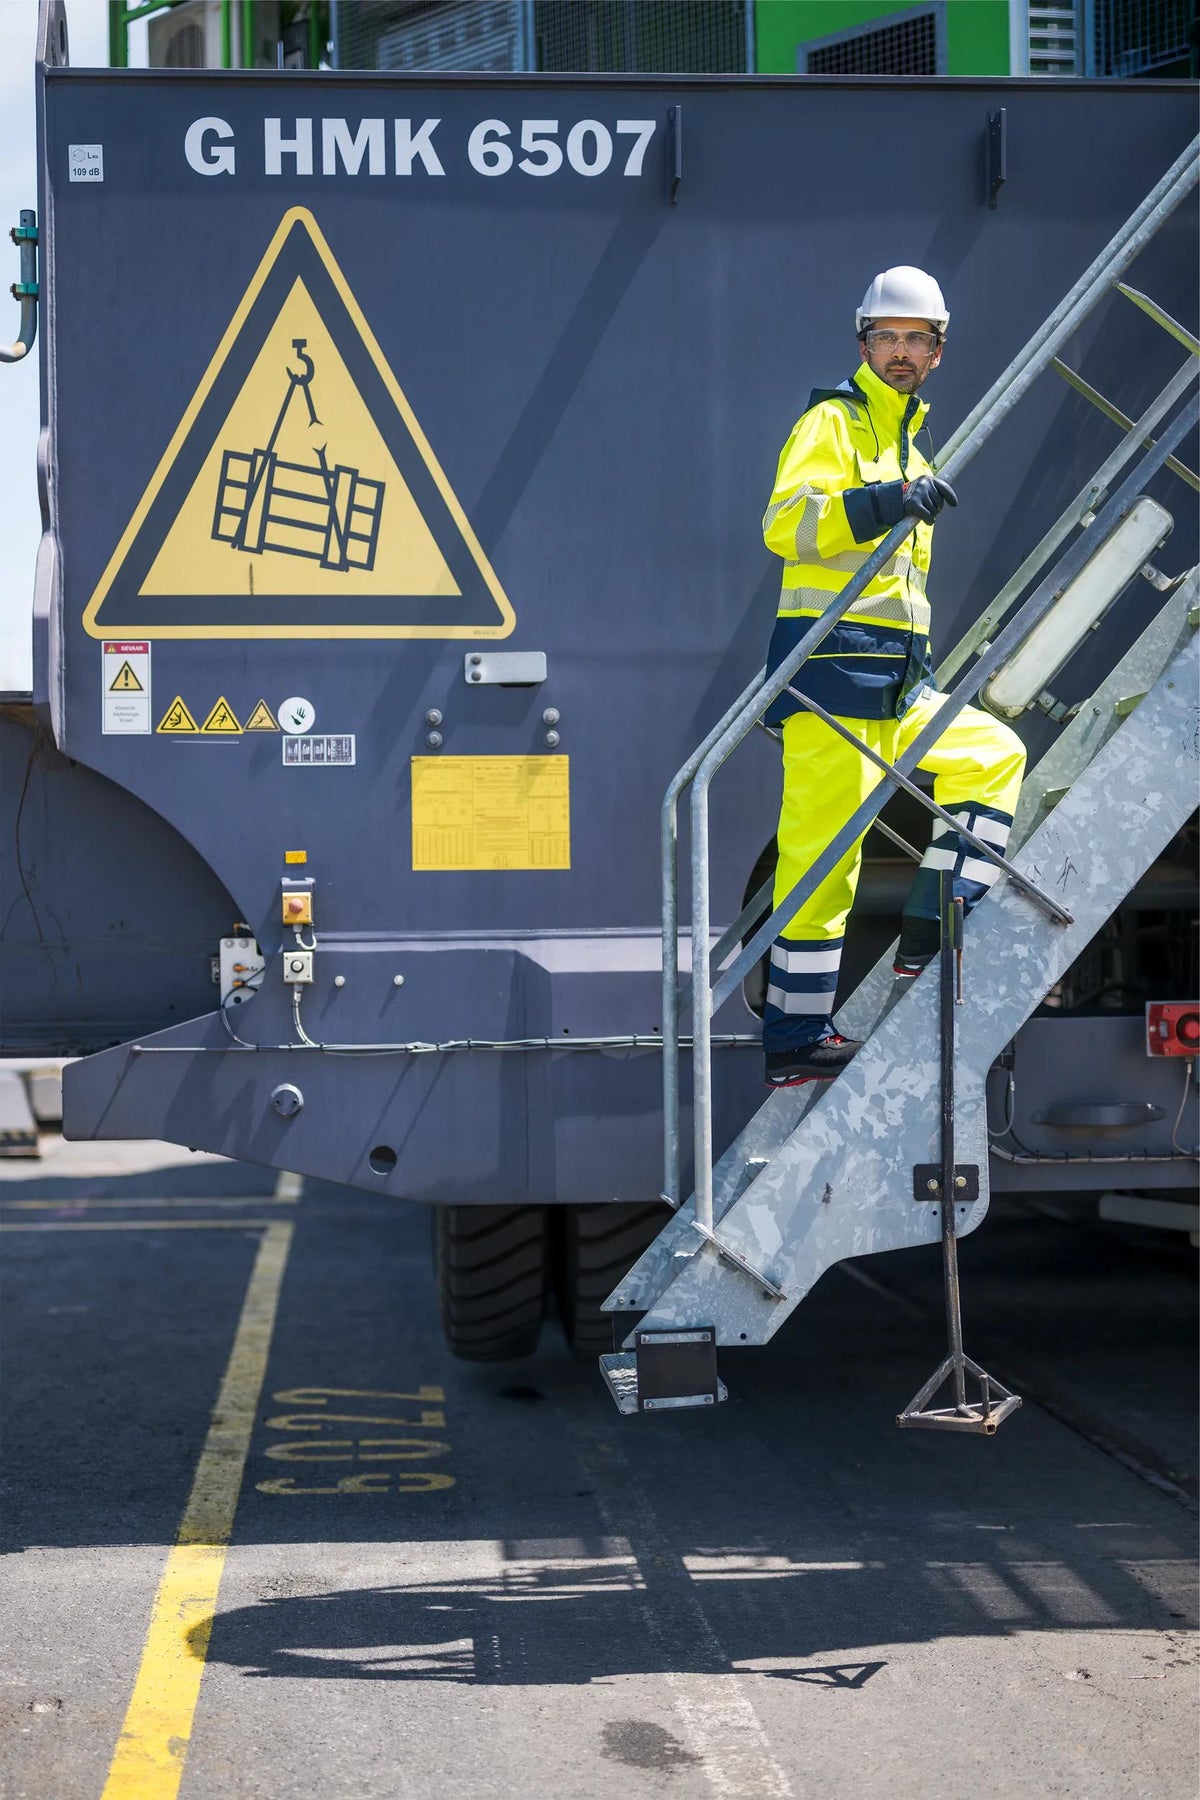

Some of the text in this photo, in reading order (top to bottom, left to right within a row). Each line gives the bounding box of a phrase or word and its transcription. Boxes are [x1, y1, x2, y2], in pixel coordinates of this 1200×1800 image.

[184, 116, 657, 178] G HMK 6507
[73, 167, 99, 176] 109 dB
